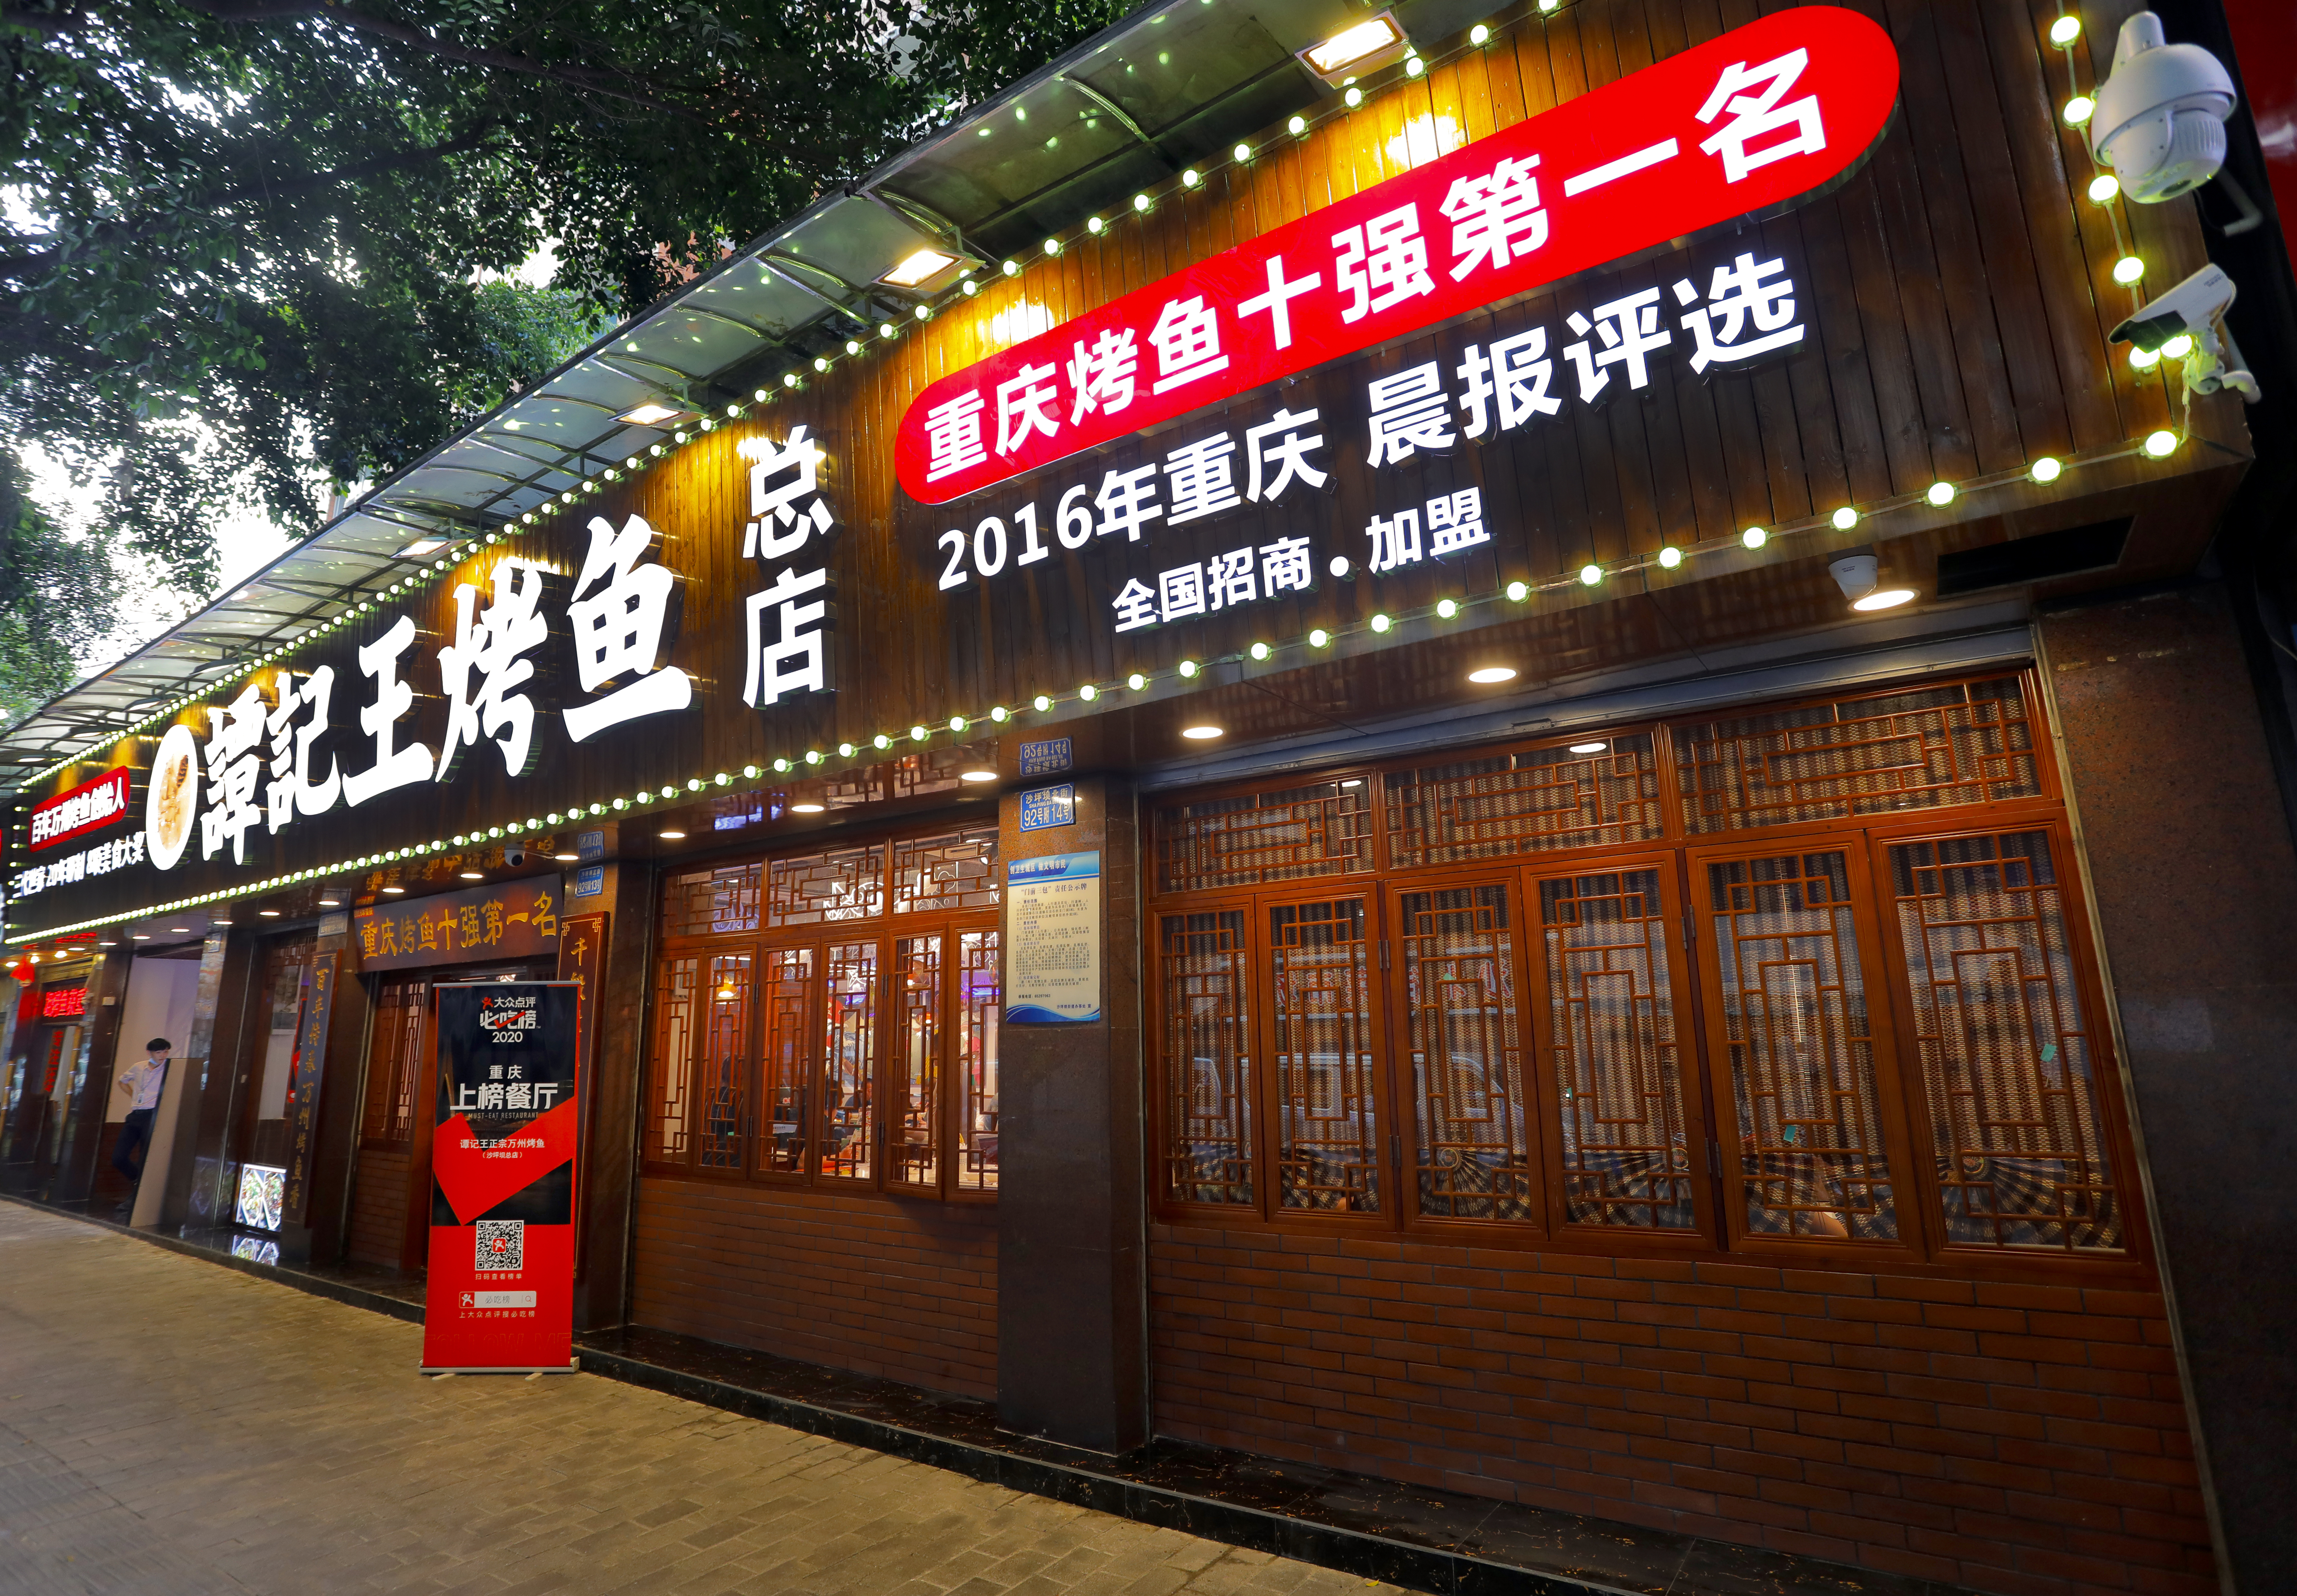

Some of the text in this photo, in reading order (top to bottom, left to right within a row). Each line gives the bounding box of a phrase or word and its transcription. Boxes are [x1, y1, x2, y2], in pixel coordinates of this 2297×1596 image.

[925, 47, 1826, 482] 重庆烤鱼十强第一名
[938, 252, 1805, 591] 2016年重庆 晨报评选
[743, 425, 834, 708] 总店
[1026, 788, 1068, 804] 沙坪坝北街
[1010, 859, 1066, 875] 创卫生城区 做文明市民
[1054, 881, 1087, 893] 责任公示牌
[361, 891, 557, 959] 重庆烤鱼十强第一名
[494, 997, 536, 1008] 大众点评
[480, 1010, 536, 1029] 必吃榜
[492, 1031, 523, 1043] 2020
[450, 1083, 558, 1110] 上榜餐厅
[460, 1139, 545, 1149] 谭记王正宗万州烤鱼
[485, 1295, 510, 1304] 必吃榜
[459, 1310, 535, 1318] 上大众点评搜必吃榜
